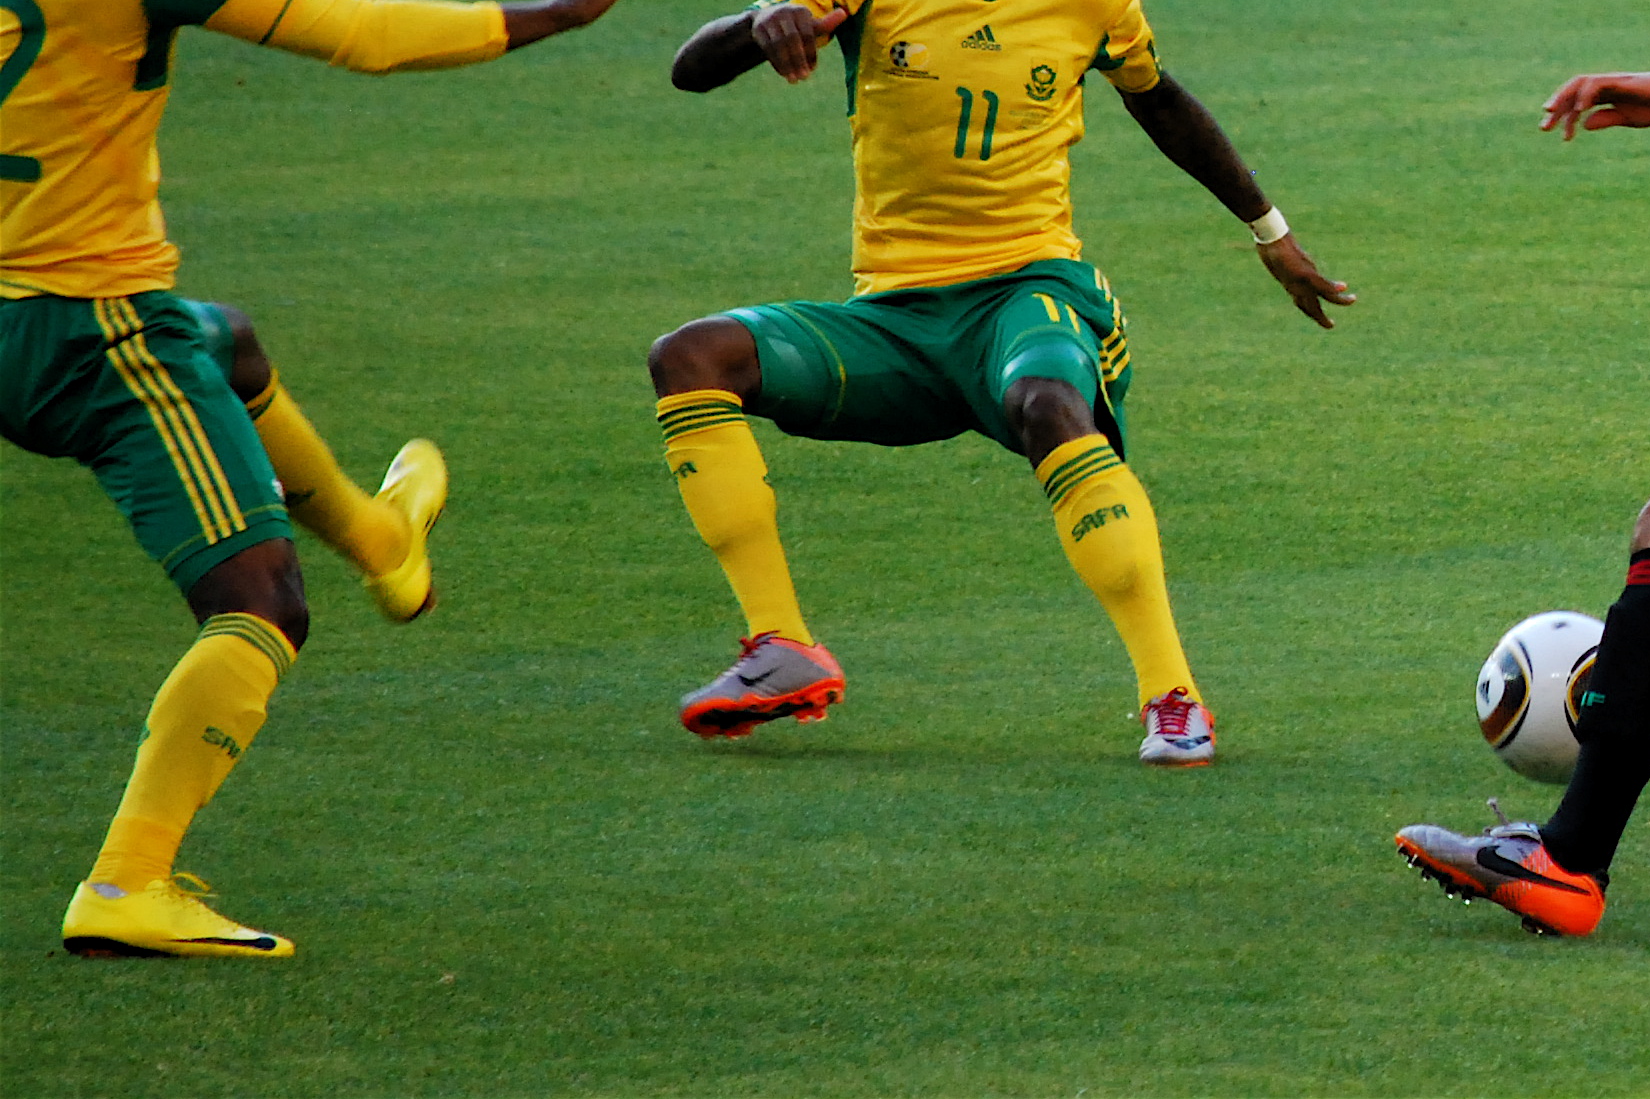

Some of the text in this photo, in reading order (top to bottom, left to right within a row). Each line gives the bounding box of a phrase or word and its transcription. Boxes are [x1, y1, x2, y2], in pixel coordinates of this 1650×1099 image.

[961, 40, 1002, 51] adidas
[954, 86, 999, 161] 11
[1032, 293, 1081, 334] 11
[1071, 504, 1130, 543] SAFA
